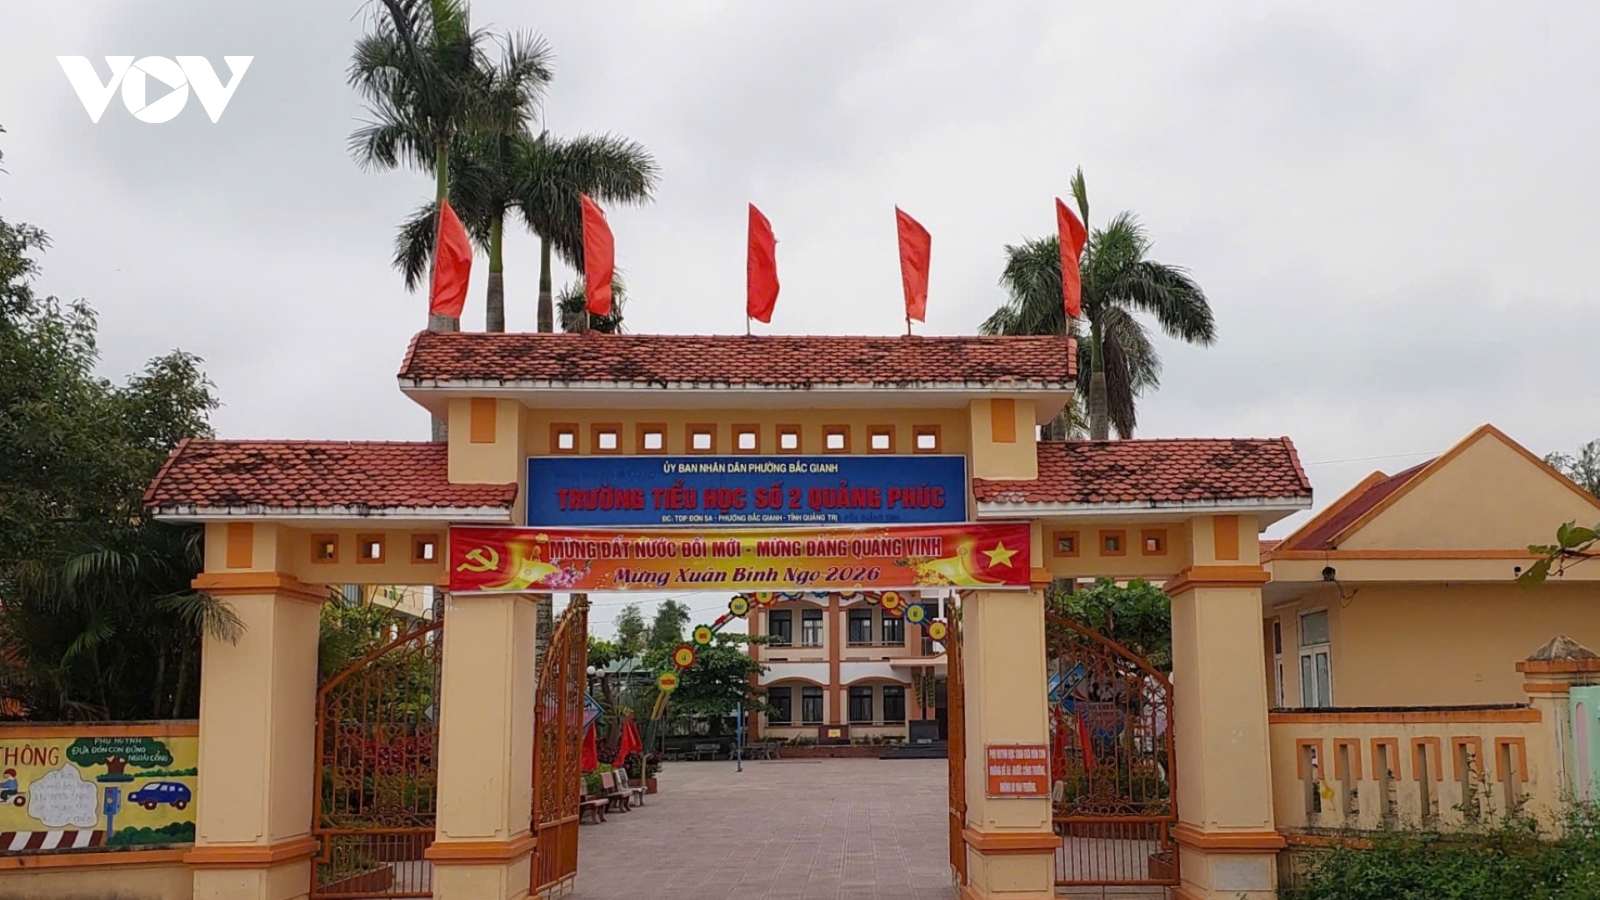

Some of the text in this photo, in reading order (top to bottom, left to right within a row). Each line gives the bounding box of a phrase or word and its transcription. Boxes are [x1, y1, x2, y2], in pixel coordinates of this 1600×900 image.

[663, 460, 838, 474] ỦY BAN NHÂN DÂN PHƯỜNG BẮC GIANH
[557, 478, 946, 515] TRƯỜNG TIỂU HỌC SỐ 2 QUẢNG PHÚC
[675, 514, 688, 522] TDP
[704, 514, 713, 522] SA
[718, 513, 747, 522] PHƯỜNG
[549, 537, 597, 559] MỪNG
[600, 535, 631, 559] ĐẤT
[633, 537, 677, 559] NƯỚC
[681, 534, 707, 559] ĐỔI
[711, 536, 741, 558] MỚI
[755, 536, 801, 558] MỪNG
[805, 534, 848, 558] ĐẢNG
[852, 537, 902, 559] QUANG
[905, 536, 942, 557] VINH
[613, 566, 882, 586] Mừng Xuân Bính Ngọ 2026
[94, 738, 111, 746] PHỤ
[91, 746, 108, 754] ĐÓN
[108, 746, 123, 754] CON
